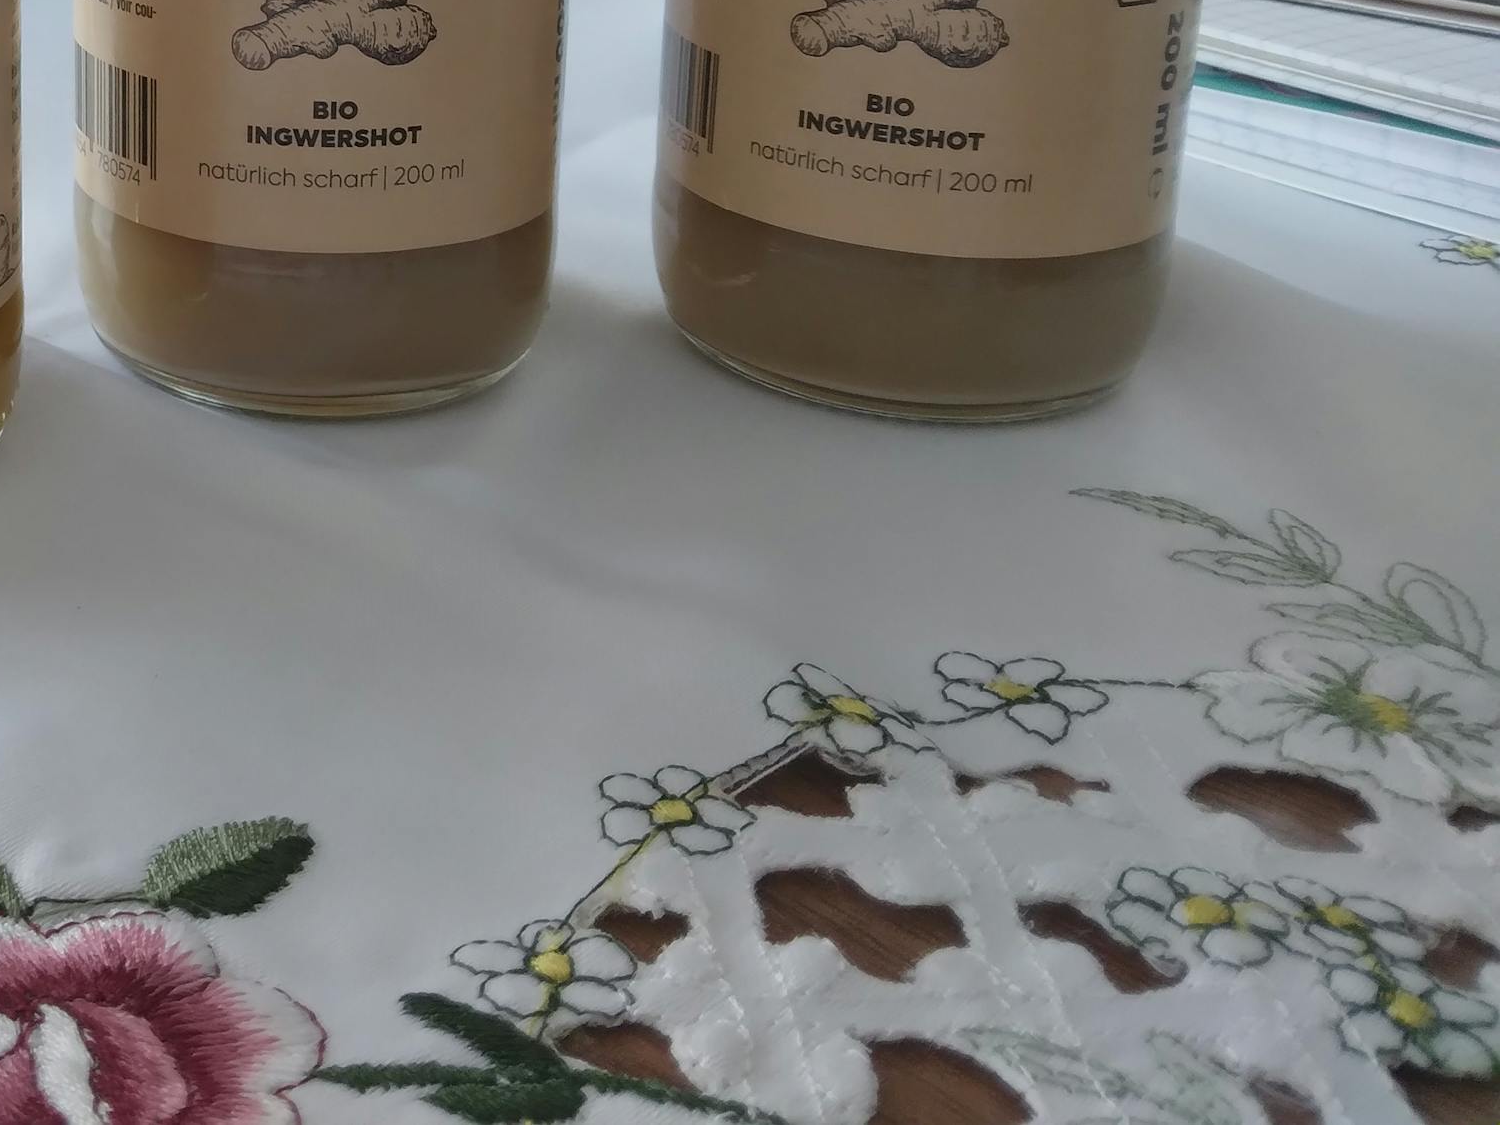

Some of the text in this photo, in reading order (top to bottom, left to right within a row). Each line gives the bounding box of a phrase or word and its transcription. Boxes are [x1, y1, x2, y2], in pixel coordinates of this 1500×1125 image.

[313, 100, 358, 120] BIO
[866, 93, 915, 117] BIO
[246, 125, 422, 148] INGWERSHOT
[797, 109, 985, 151] INGWERSHOT
[199, 158, 465, 189] natürlich scharf 200 ml
[750, 140, 1032, 193] natürlich scharf 200 ml
